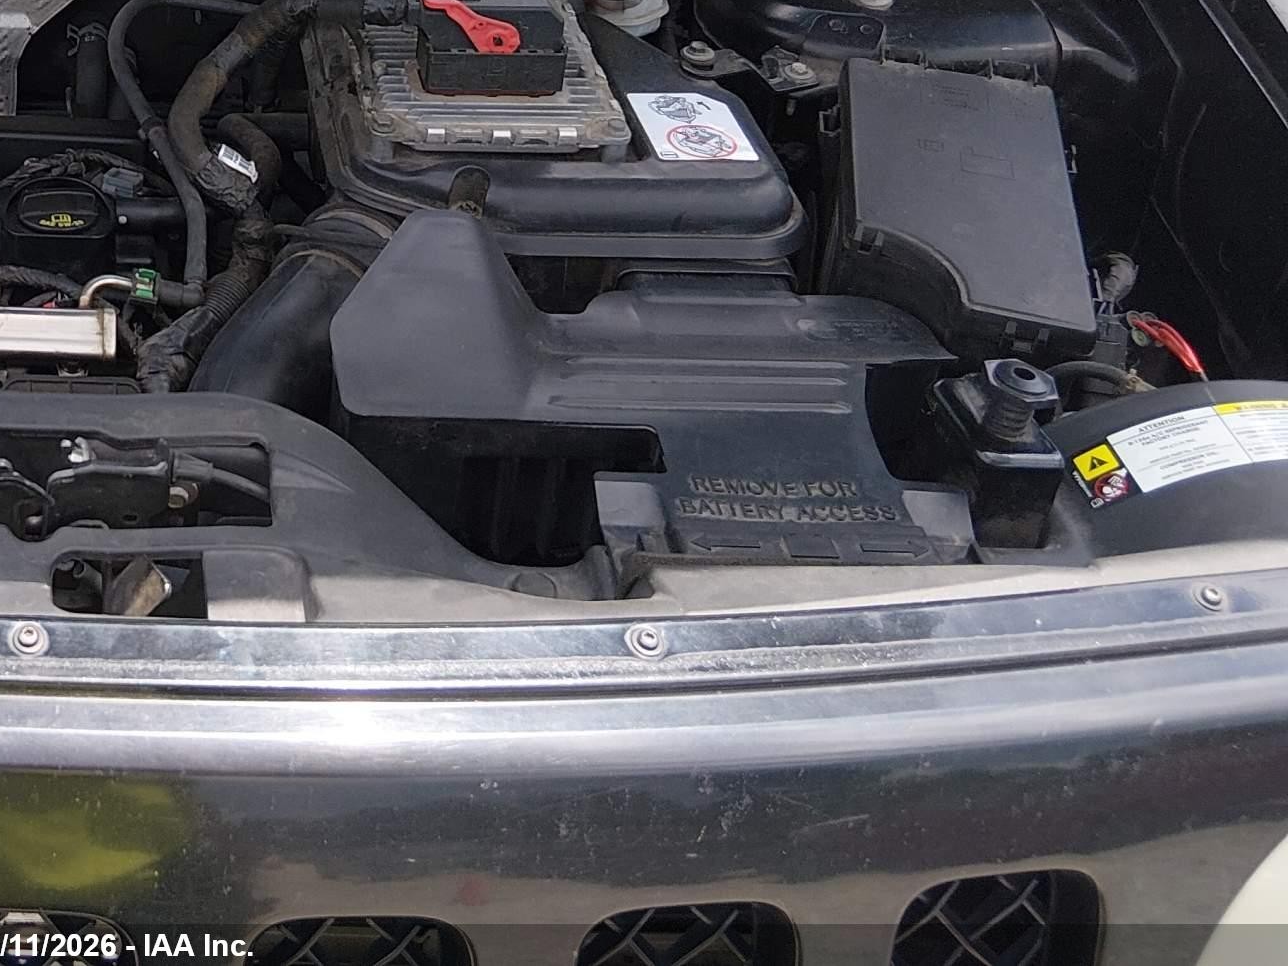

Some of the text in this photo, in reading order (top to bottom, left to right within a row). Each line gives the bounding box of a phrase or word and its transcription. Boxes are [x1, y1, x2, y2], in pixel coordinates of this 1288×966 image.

[1138, 415, 1185, 433] ATTENTION
[688, 475, 857, 498] REMOVE FOR
[677, 497, 900, 523] BATTERY ACCESS
